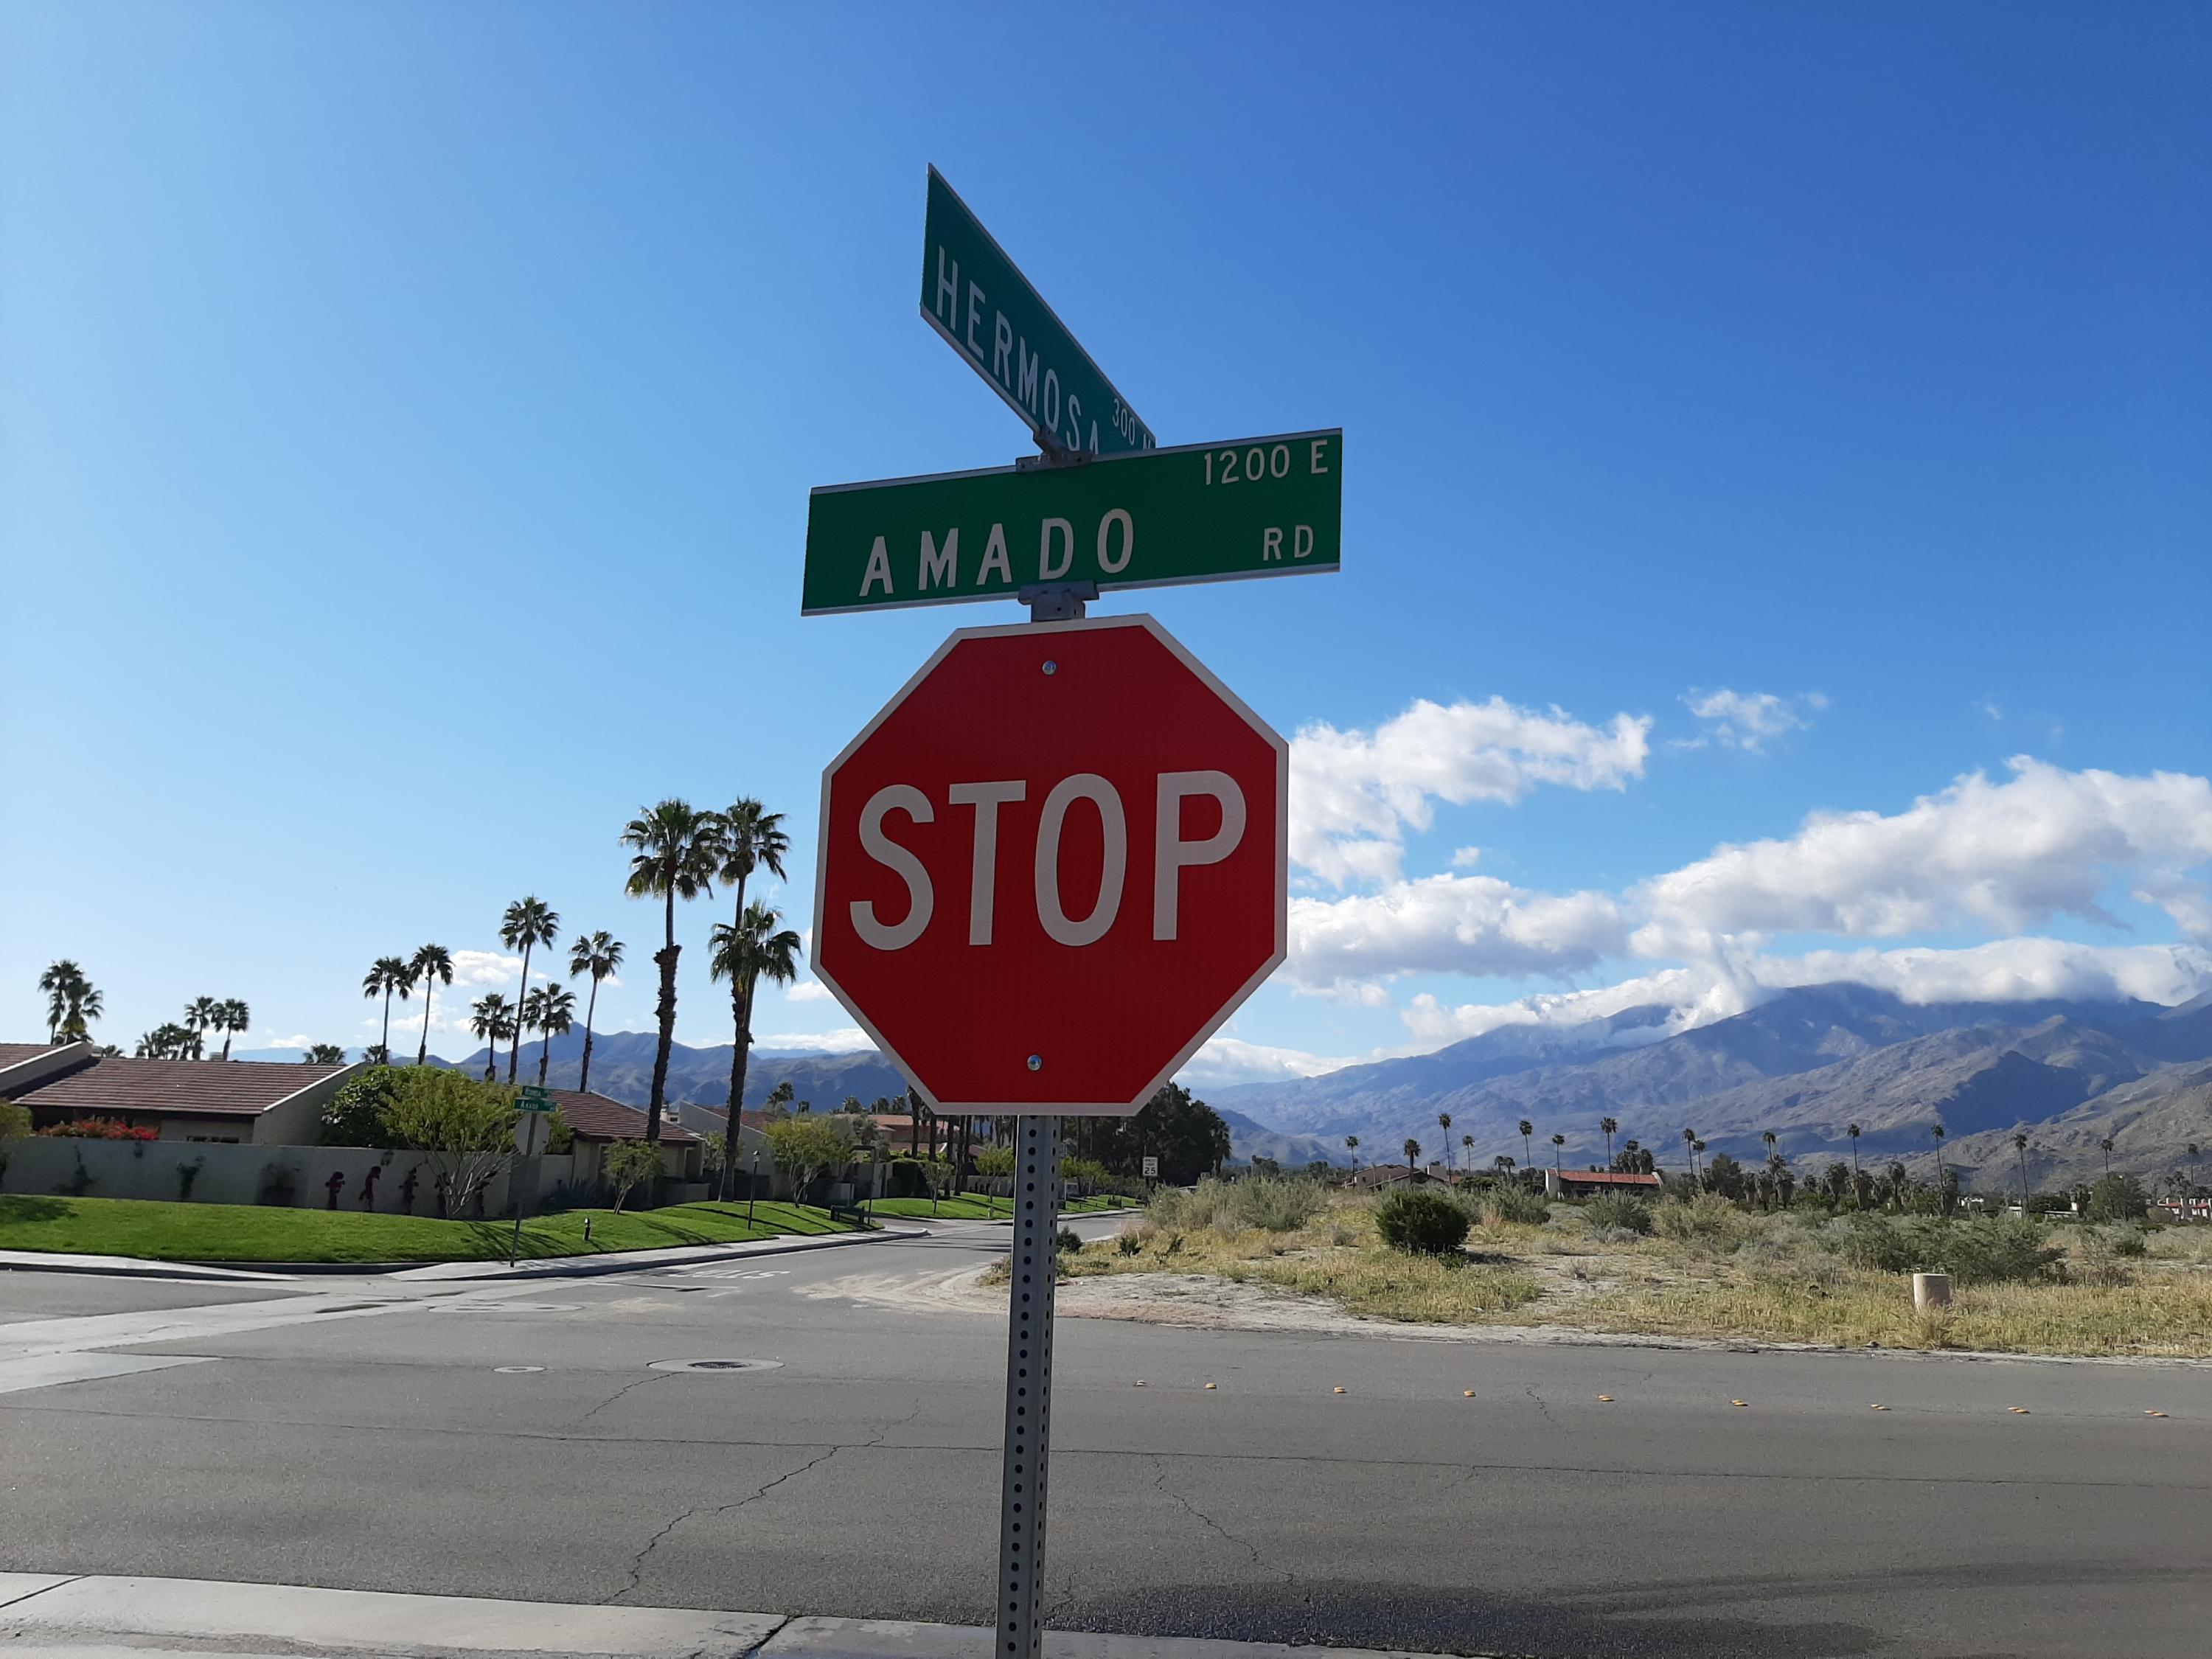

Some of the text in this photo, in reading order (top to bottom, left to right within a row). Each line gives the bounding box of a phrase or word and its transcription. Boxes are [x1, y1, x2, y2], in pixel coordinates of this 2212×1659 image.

[936, 245, 1099, 455] HERMOSA
[1112, 398, 1135, 445] 300
[1204, 439, 1329, 485] 1200 E
[859, 508, 1134, 597] AMADO
[1263, 525, 1314, 561] RD
[849, 770, 1247, 950] STOP
[1144, 1166, 1156, 1175] 25
